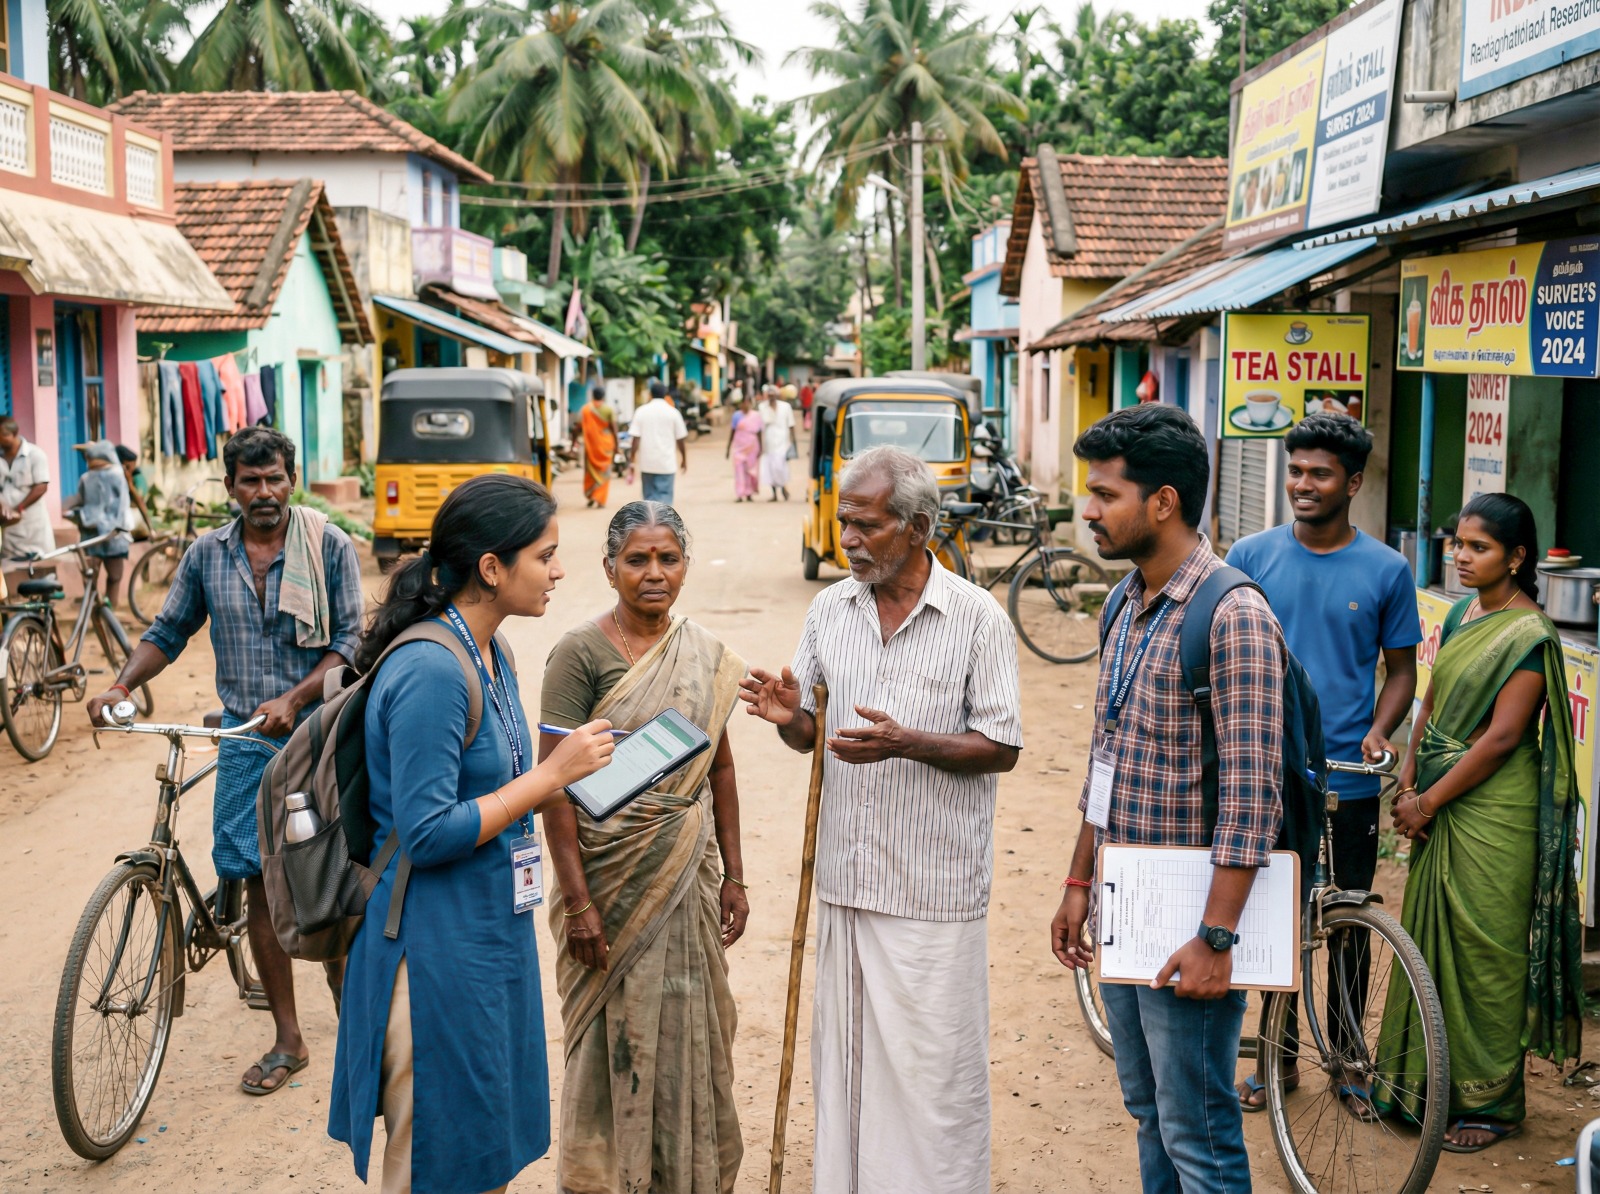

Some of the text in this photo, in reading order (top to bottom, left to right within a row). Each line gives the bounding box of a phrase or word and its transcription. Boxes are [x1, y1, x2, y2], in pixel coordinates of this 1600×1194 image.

[1356, 46, 1385, 87] STALL
[1326, 100, 1376, 138] SURVEY 2024
[1545, 310, 1585, 330] VOICE
[1541, 337, 1586, 364] 2024
[1232, 351, 1363, 382] TEA STALL
[1469, 374, 1508, 401] SURVEY
[1468, 411, 1502, 447] 2024
